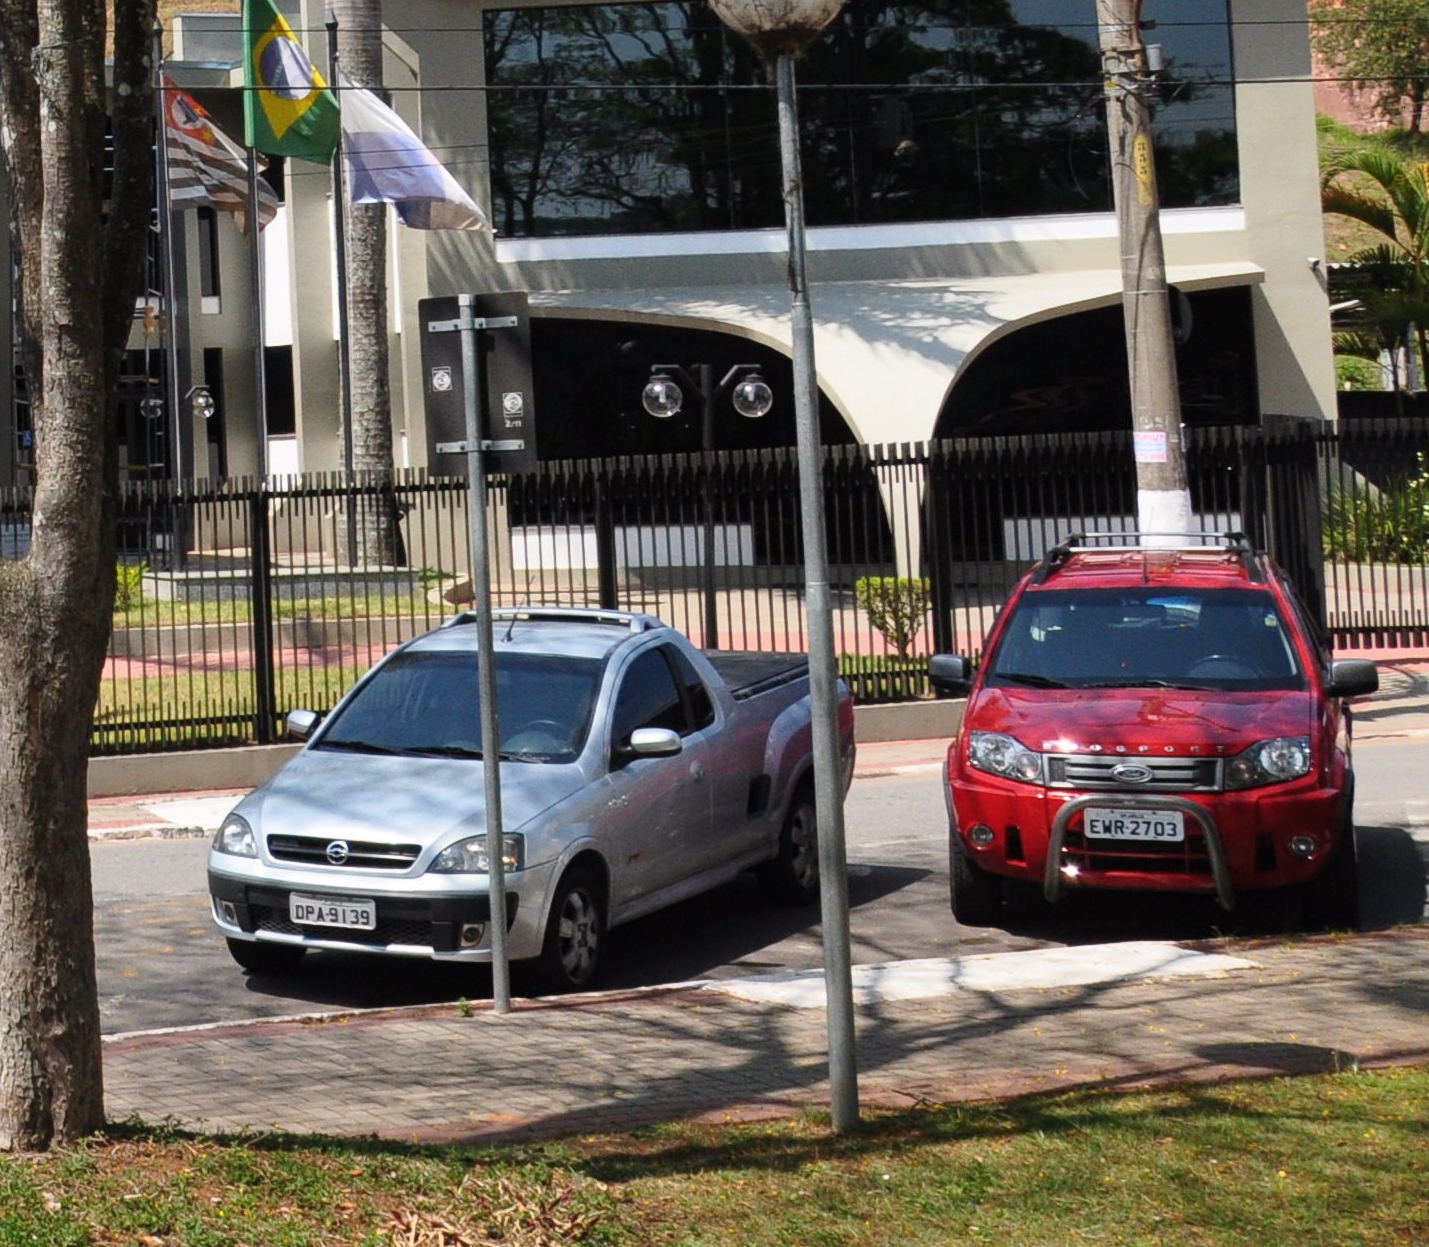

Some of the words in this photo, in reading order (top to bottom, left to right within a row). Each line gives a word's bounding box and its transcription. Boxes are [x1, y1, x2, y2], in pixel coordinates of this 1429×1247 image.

[1042, 742, 1225, 753] EOSPORT
[1090, 819, 1177, 837] EWR-2703
[295, 905, 370, 925] DPA-9139
